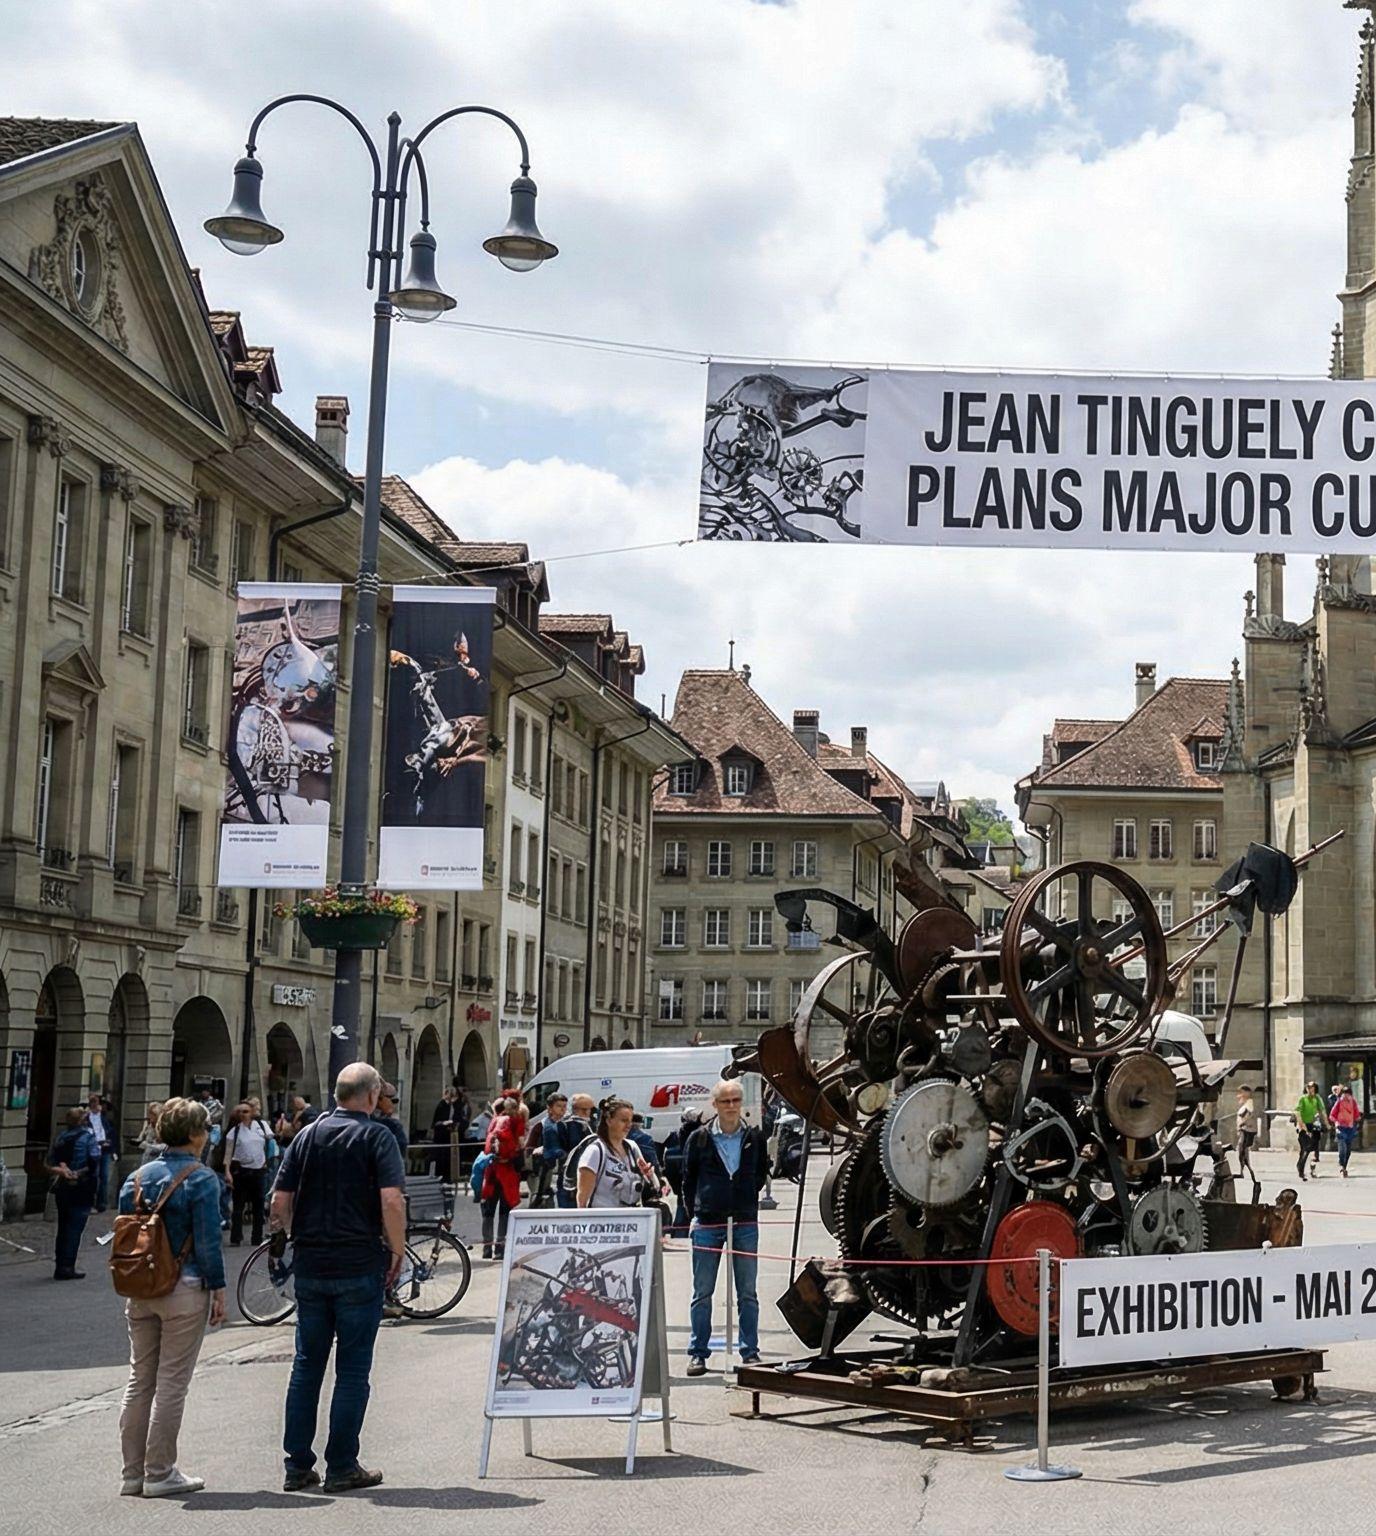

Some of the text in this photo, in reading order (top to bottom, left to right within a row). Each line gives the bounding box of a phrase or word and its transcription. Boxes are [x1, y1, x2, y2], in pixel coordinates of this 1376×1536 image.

[924, 391, 1061, 455] JEAN
[1077, 394, 1326, 460] TINGUELY
[907, 464, 1083, 532] PLANS
[1102, 469, 1292, 536] MAJOR
[1076, 1276, 1263, 1339] EXHIBITION
[1272, 1294, 1286, 1304] -
[1295, 1270, 1352, 1320] MAI
